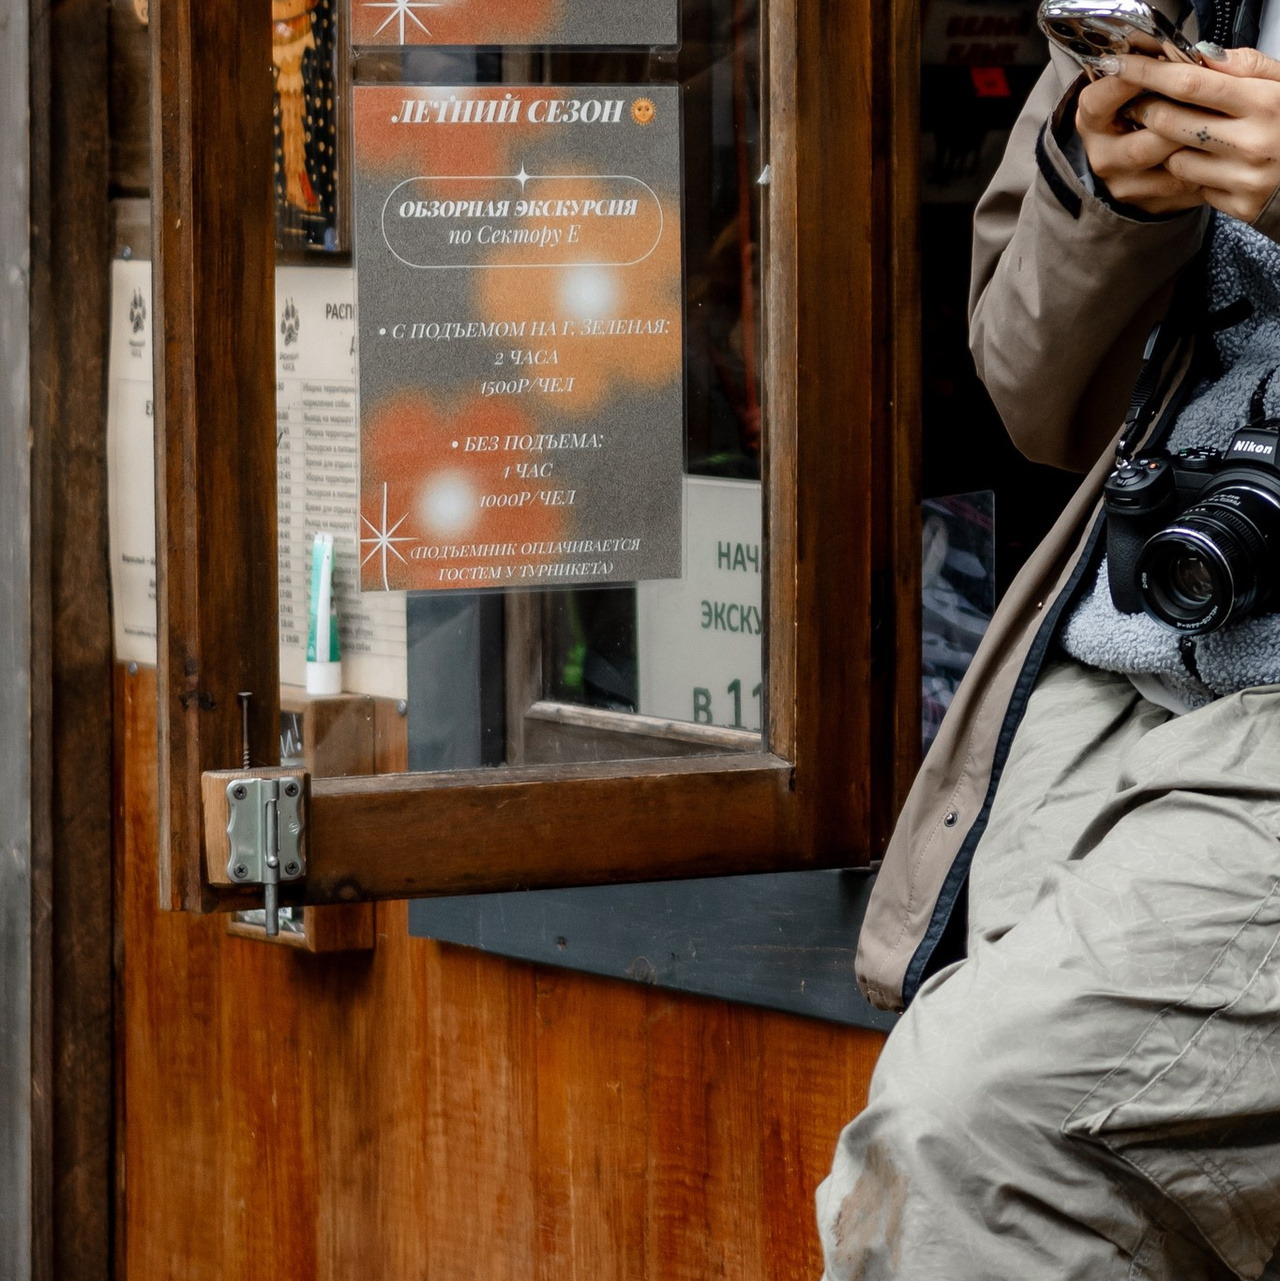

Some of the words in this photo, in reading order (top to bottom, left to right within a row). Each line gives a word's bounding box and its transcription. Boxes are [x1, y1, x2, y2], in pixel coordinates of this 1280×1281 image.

[391, 93, 522, 124] ЛЕТНИЙ
[527, 99, 625, 123] СЕЗОН
[400, 200, 510, 218] ОБЗОРНАЯ
[514, 199, 638, 217] ЭКСКУРСИЯ
[449, 228, 472, 245] по
[478, 225, 562, 247] Сектору
[411, 321, 527, 340] ПОДЪЕМОМ
[531, 321, 557, 336] НА
[580, 318, 670, 336] ЗЕЛЕНАЯ:
[494, 351, 505, 366] 2
[510, 349, 559, 365] ЧАСА
[480, 377, 575, 397] 1500Р/ЧЕЛ
[464, 435, 499, 452] БЕЗ
[503, 432, 604, 453] ПОДЪЕМА:
[1233, 440, 1273, 455] Nikon
[503, 466, 511, 479] 1
[515, 463, 554, 478] ЧАС
[480, 489, 577, 508] 1000Р/ЧЕЛ
[410, 542, 518, 560] (ПОДЪЕМНИК
[521, 538, 641, 555] ОПЛАЧИВАЕТСЯ
[718, 541, 762, 573] НАЧ
[438, 565, 501, 582] ГОСТЕМ
[504, 566, 517, 579] У
[519, 561, 614, 578] ТУРНИКЕТА)
[693, 686, 713, 725] В
